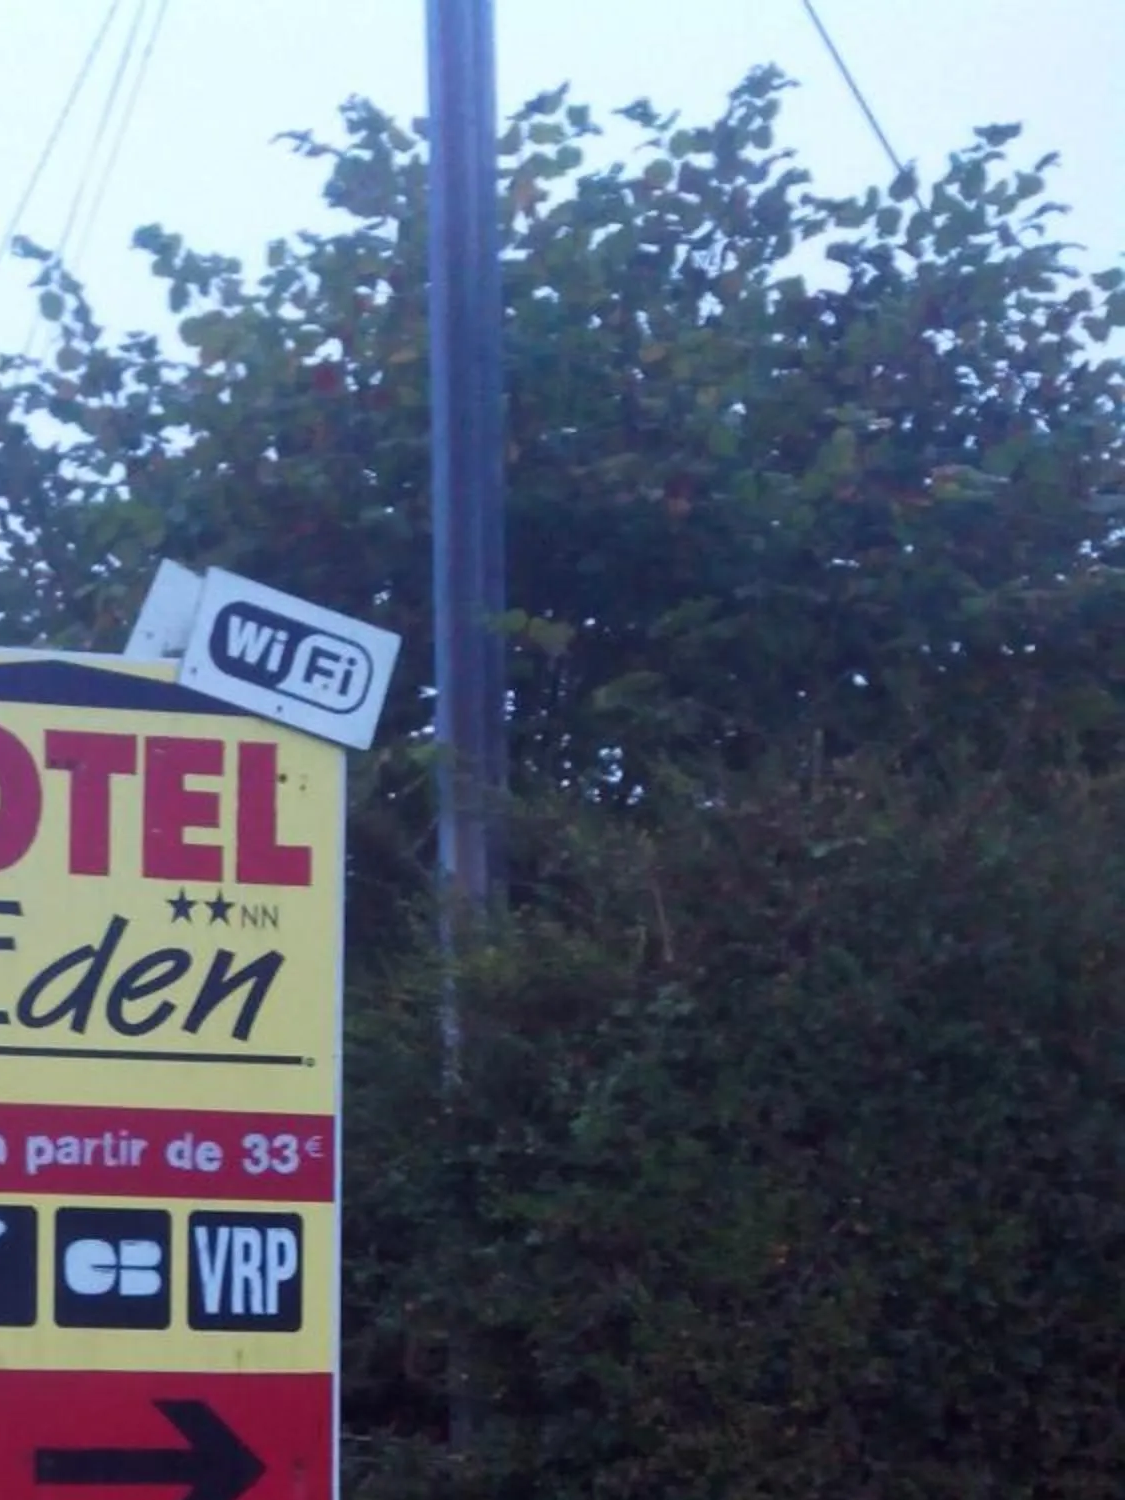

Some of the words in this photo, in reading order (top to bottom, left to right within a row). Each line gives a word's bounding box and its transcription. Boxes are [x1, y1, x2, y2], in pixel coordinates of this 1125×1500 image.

[241, 904, 279, 929] NN
[25, 1129, 148, 1175] partir
[165, 1133, 224, 1173] de
[193, 1226, 299, 1315] VRP
